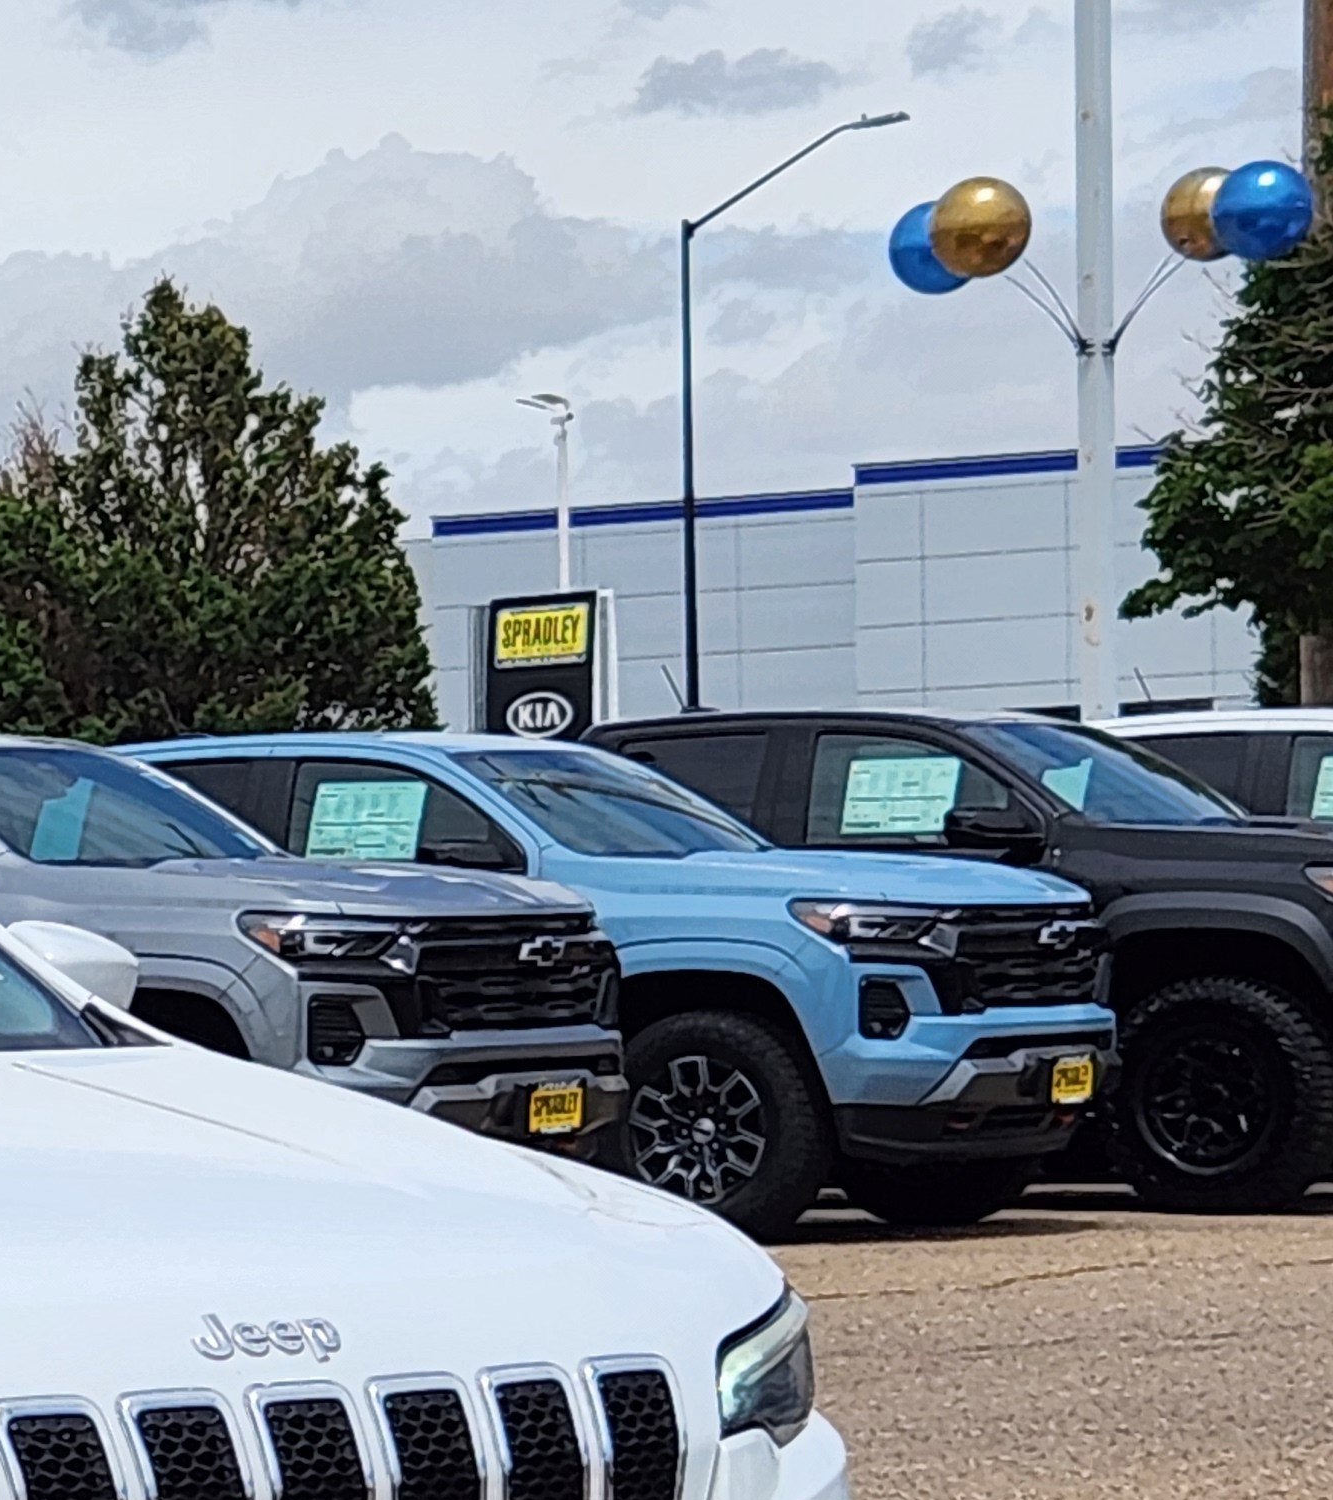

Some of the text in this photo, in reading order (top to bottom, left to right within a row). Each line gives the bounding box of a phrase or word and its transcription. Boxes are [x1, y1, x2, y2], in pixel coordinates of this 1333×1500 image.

[502, 614, 581, 648] SPRADLEY
[518, 701, 561, 728] KIA
[190, 1313, 341, 1363] Jeep
